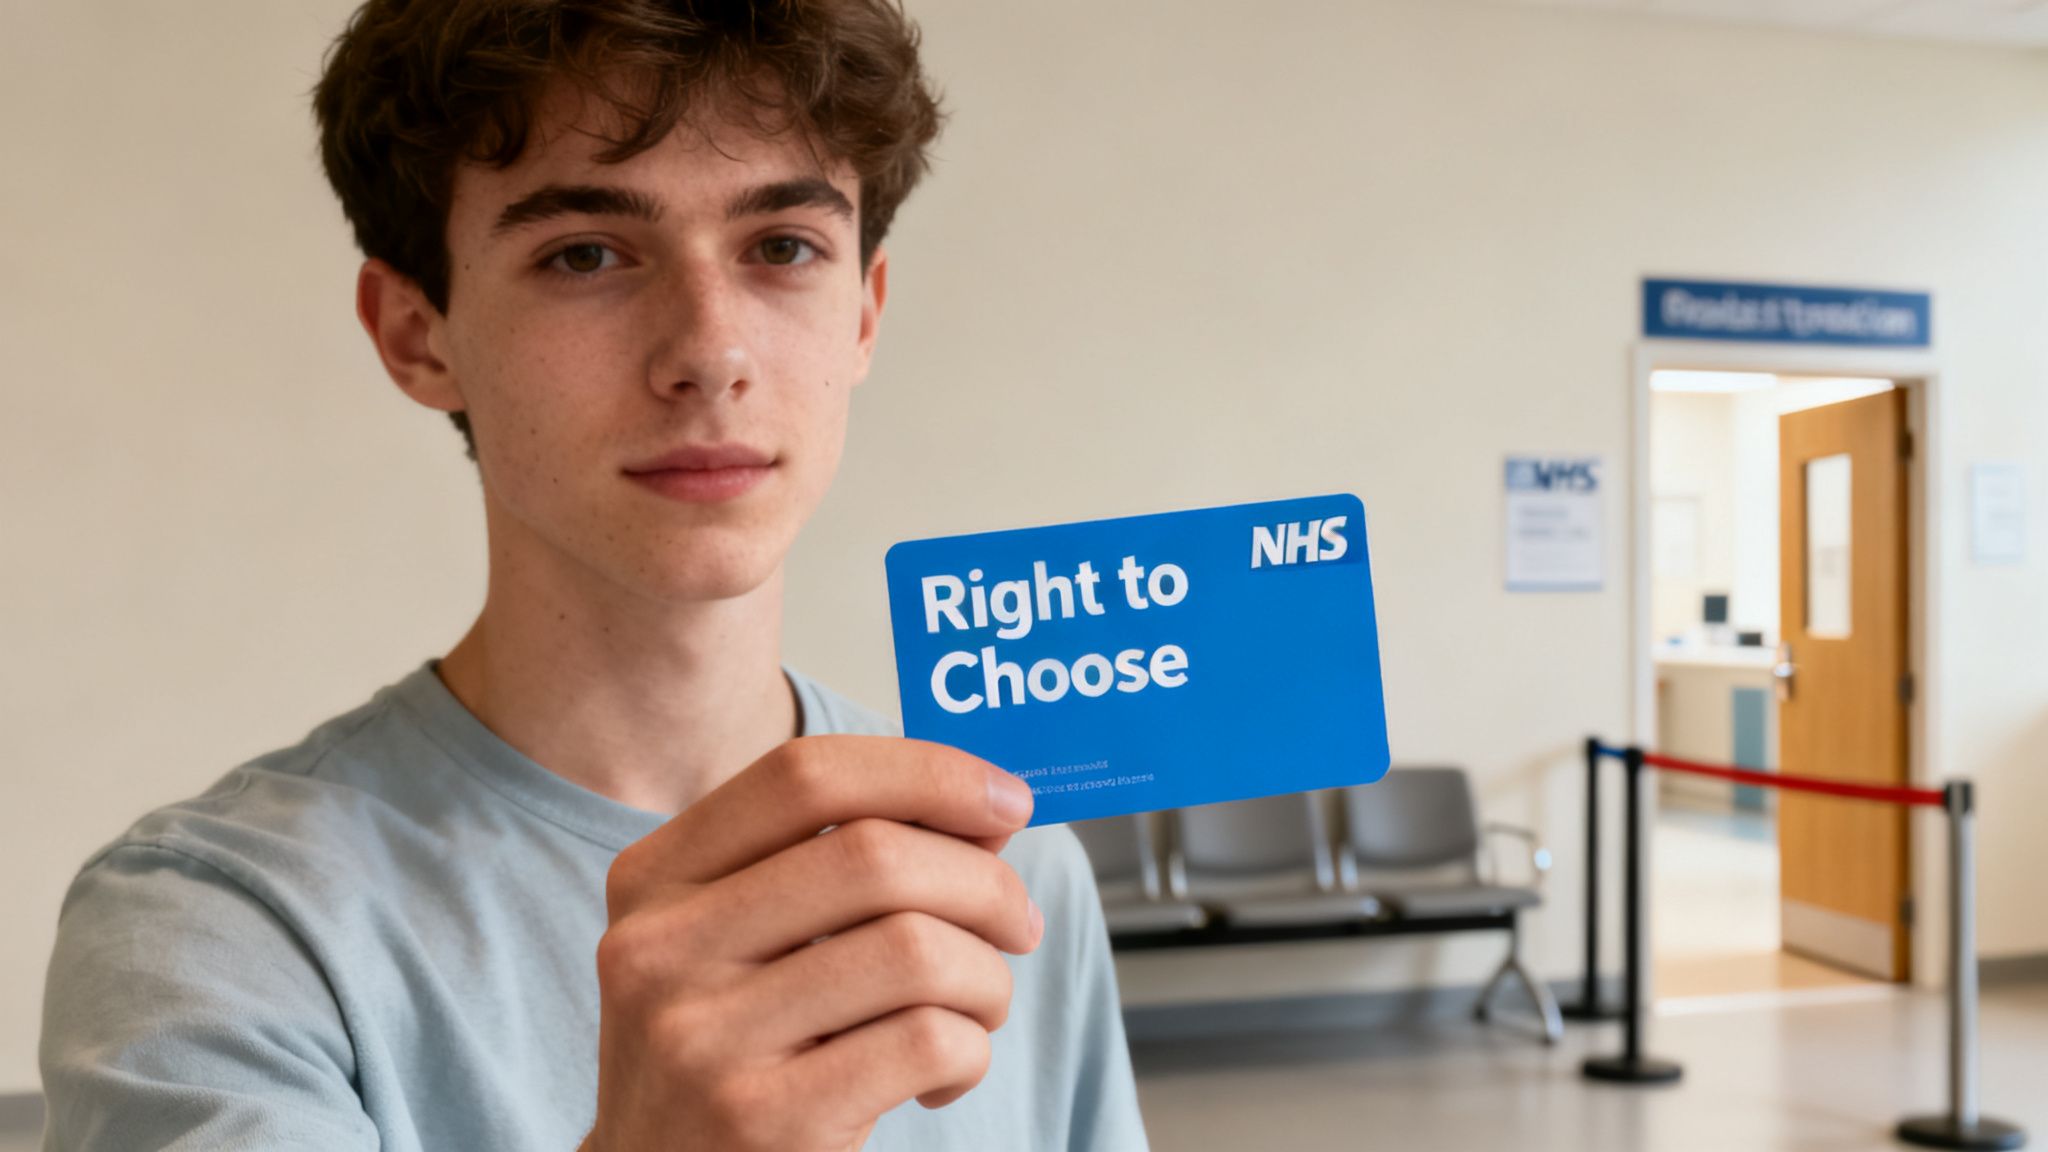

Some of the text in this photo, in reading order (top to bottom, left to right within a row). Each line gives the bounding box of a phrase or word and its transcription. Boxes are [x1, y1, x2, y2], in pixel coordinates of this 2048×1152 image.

[1251, 516, 1348, 568] NHS
[921, 555, 1189, 640] Right to
[930, 644, 1189, 714] Choose
